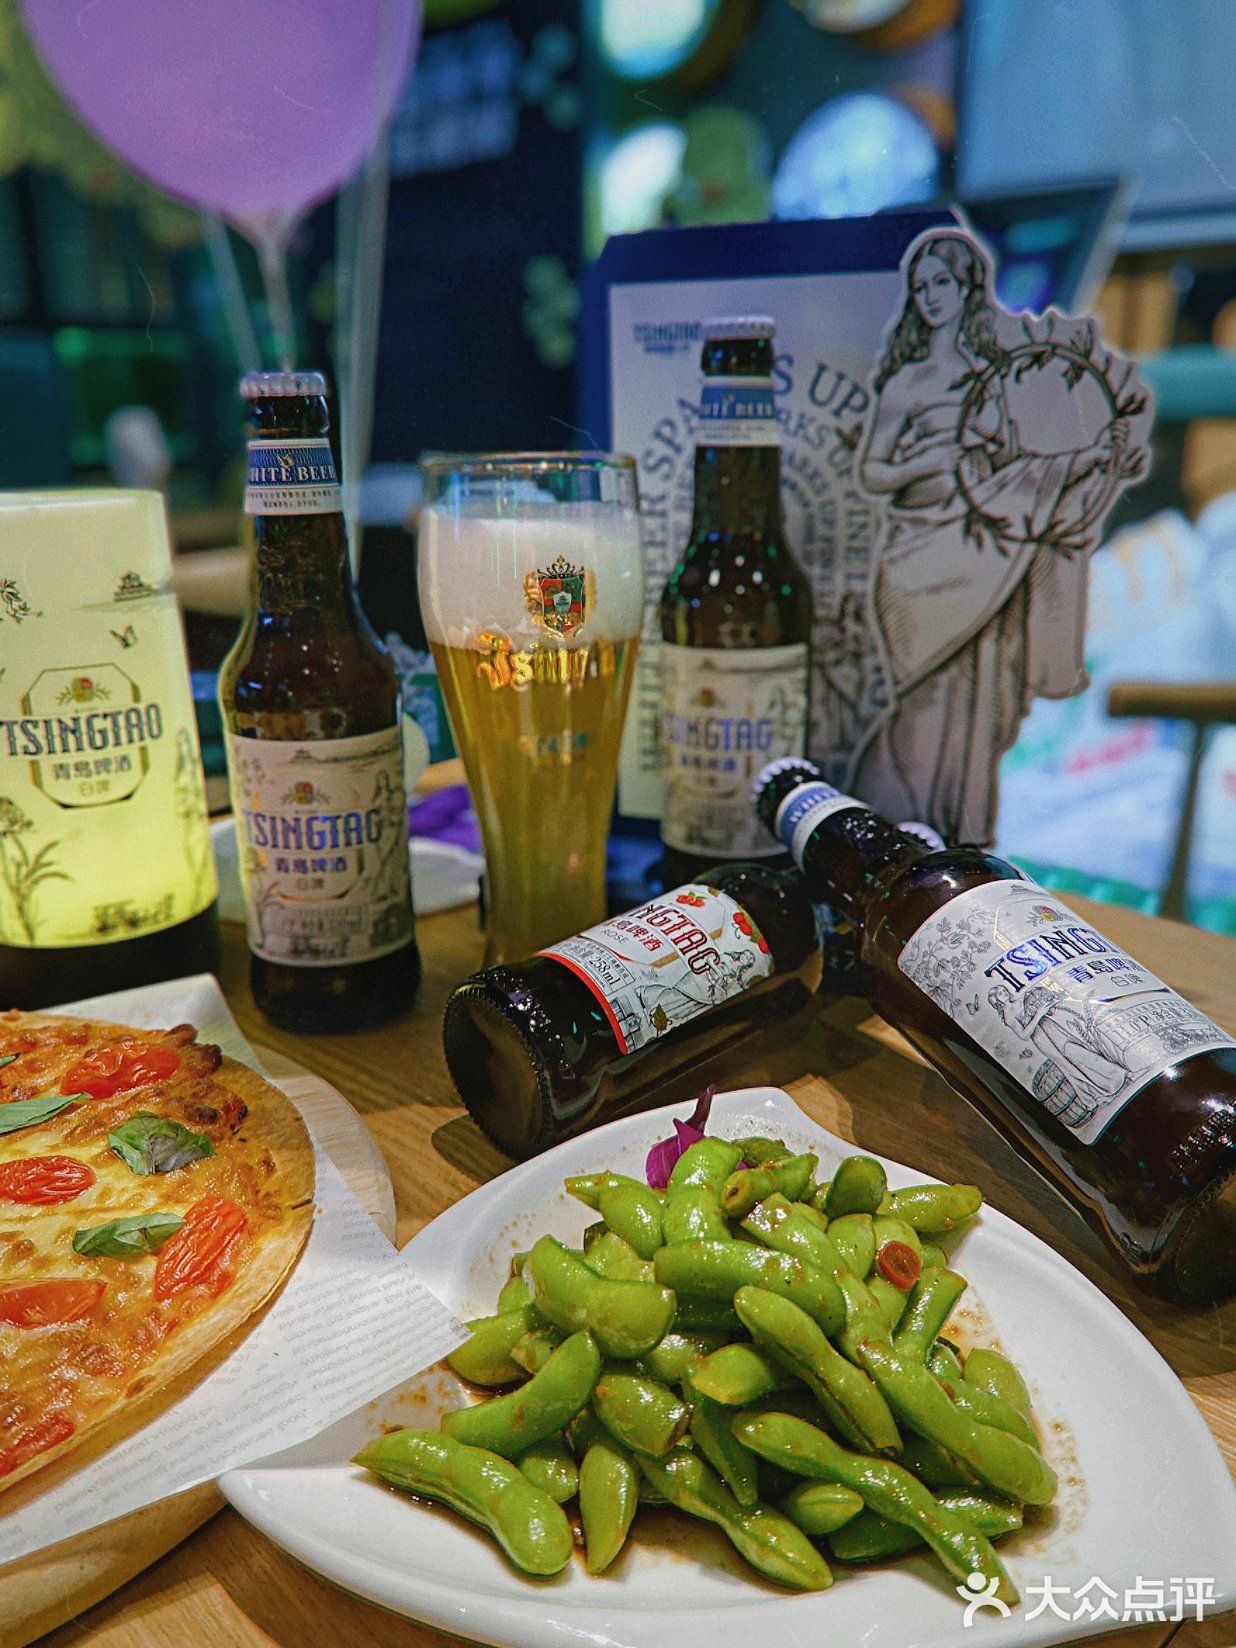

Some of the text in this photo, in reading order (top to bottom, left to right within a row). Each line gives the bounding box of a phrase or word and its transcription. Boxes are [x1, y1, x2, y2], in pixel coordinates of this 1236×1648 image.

[809, 362, 869, 417] UP
[249, 466, 292, 482] HITE
[0, 703, 163, 757] TSINGTAO
